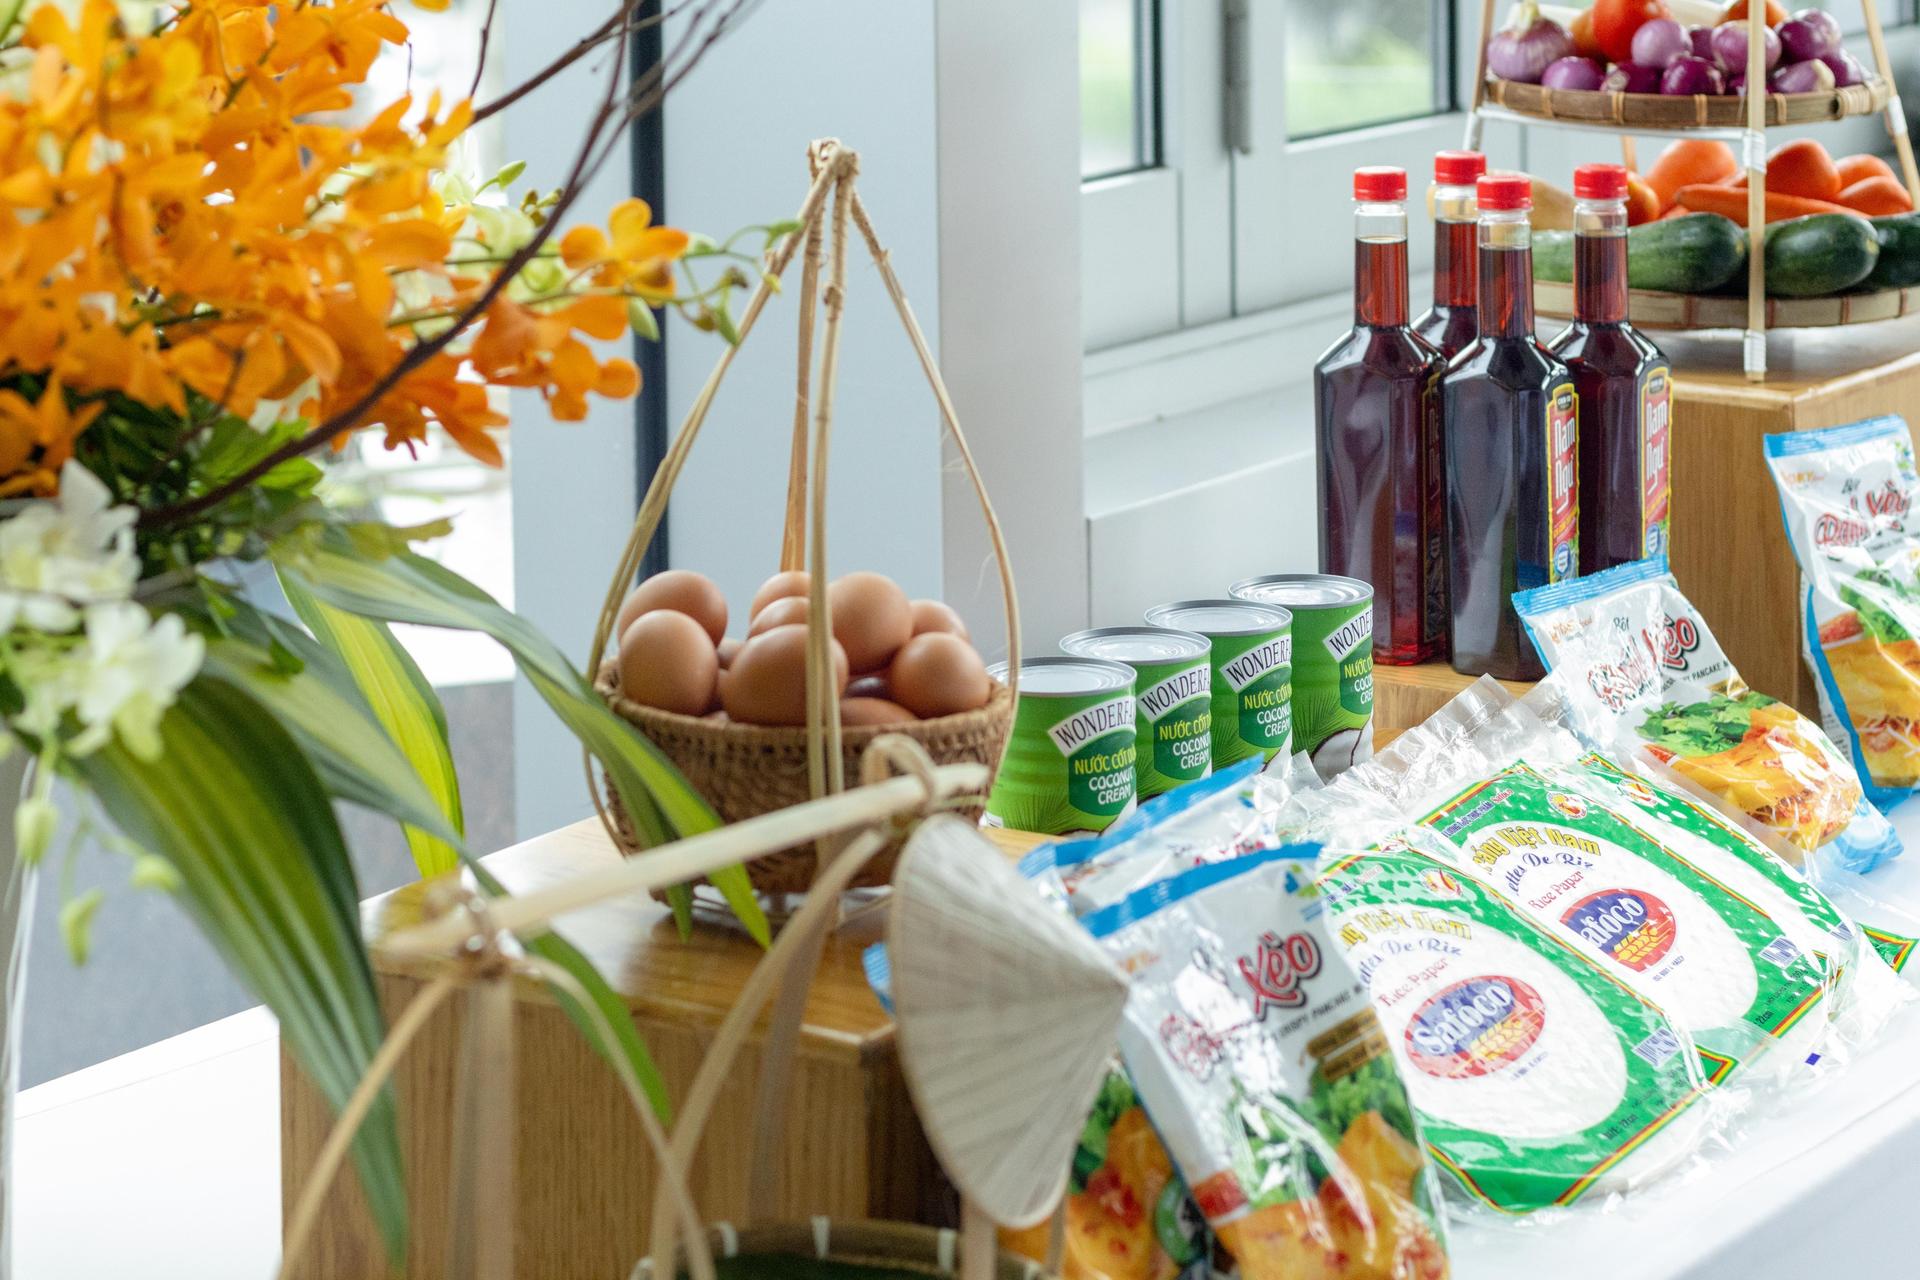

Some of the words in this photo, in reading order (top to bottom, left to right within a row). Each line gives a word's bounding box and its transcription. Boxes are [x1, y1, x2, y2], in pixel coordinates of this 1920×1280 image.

[1555, 417, 1575, 459] Nam
[1647, 400, 1667, 441] Nam
[1691, 662, 1721, 680] PANCAKE
[1097, 783, 1132, 805] CREAM
[1496, 825, 1547, 849] Việt
[1545, 827, 1602, 856] Nam
[1522, 852, 1553, 867] De
[1555, 852, 1594, 869] Riz
[1528, 889, 1557, 911] Rice
[1555, 871, 1584, 896] Paper
[1412, 911, 1472, 940] Nam
[1580, 897, 1645, 948] afoco
[1381, 939, 1413, 956] De
[1418, 937, 1463, 956] Riz
[1238, 930, 1322, 1022] Xèo
[1378, 984, 1415, 1008] Rice
[1407, 957, 1449, 986] Paper
[1413, 984, 1512, 1055] Safoco
